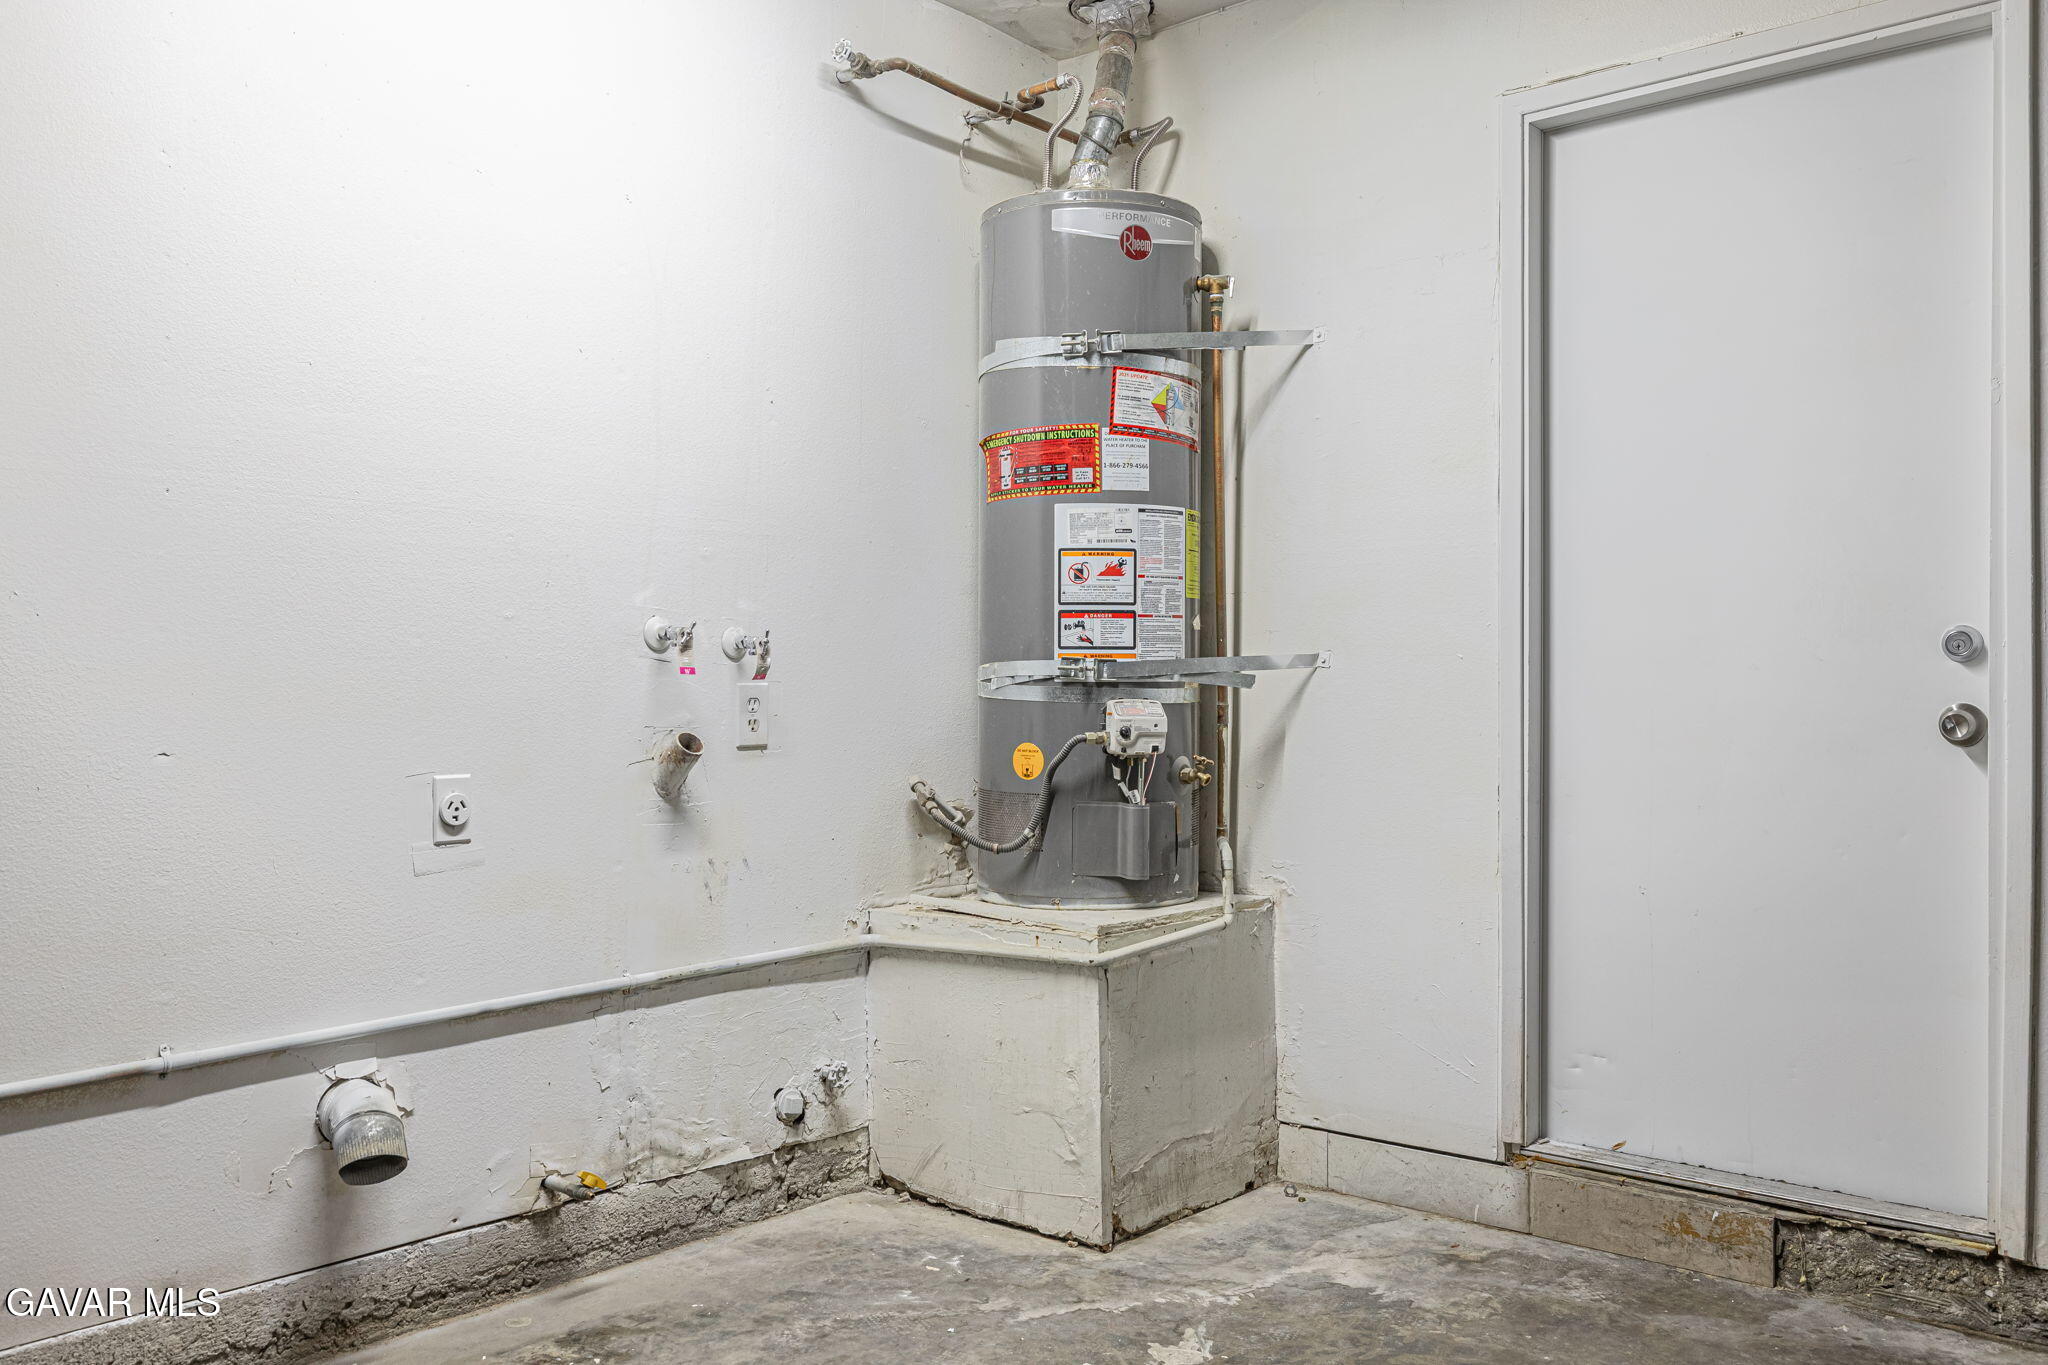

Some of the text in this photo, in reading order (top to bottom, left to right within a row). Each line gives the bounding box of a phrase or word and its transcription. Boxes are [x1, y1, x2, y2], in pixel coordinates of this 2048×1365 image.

[1103, 211, 1171, 227] ERFORMANCE
[1123, 225, 1151, 255] Rheem
[986, 436, 1013, 449] EMERGENCY
[1013, 431, 1046, 443] SHUTDOWN
[1046, 429, 1095, 440] INSTRUCTIONS
